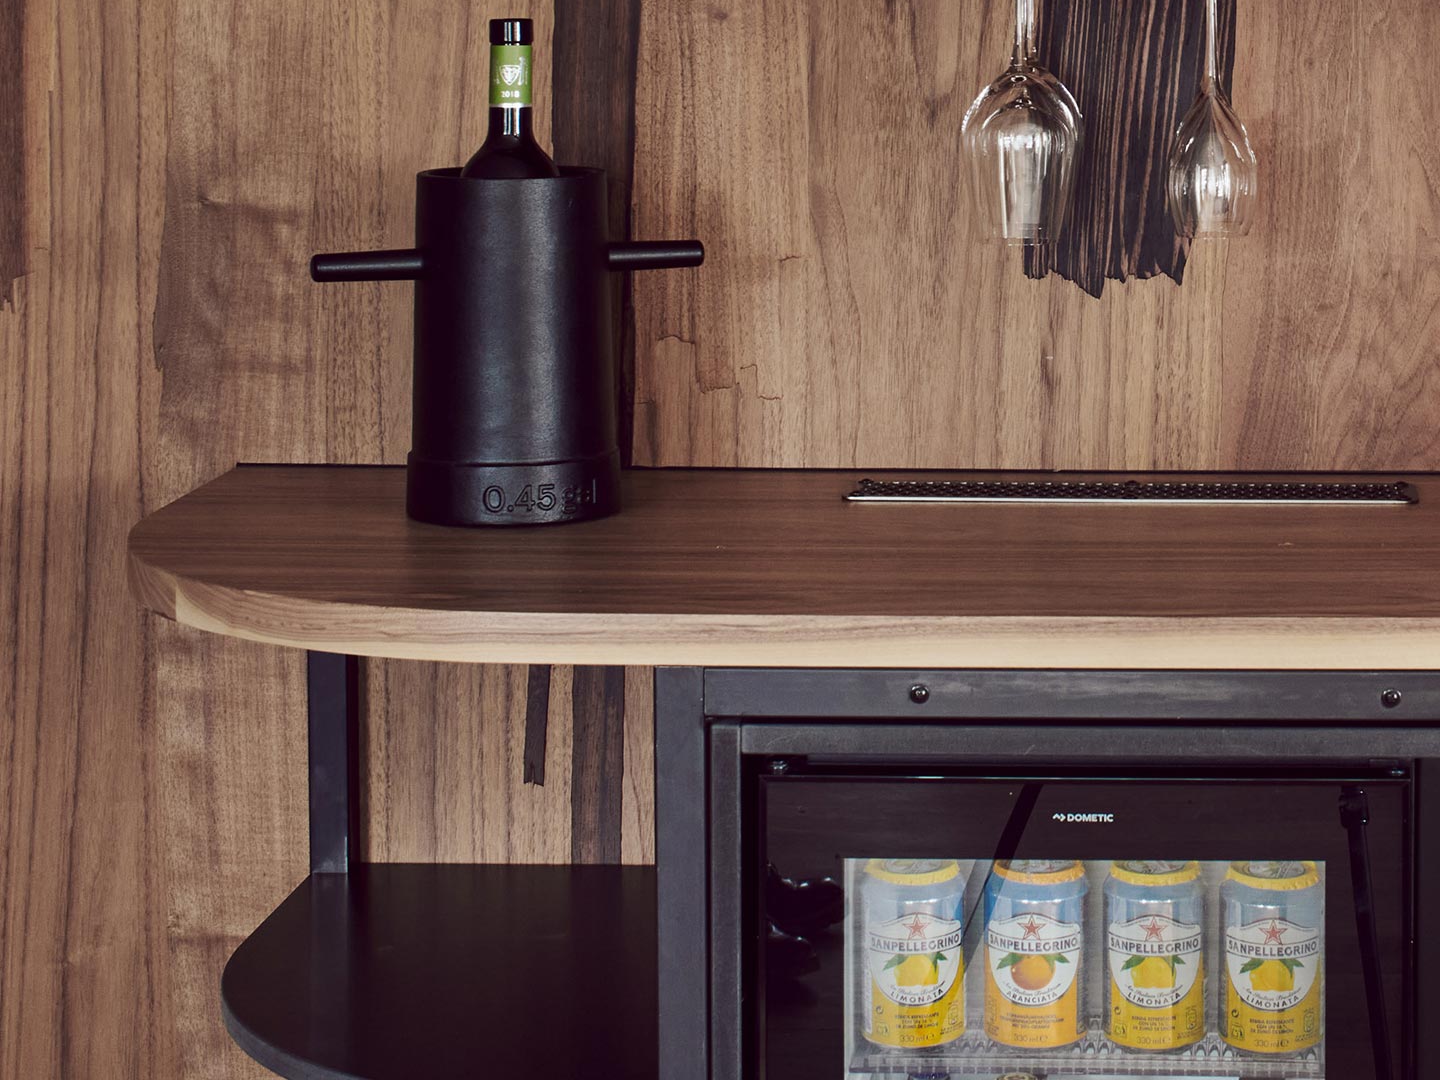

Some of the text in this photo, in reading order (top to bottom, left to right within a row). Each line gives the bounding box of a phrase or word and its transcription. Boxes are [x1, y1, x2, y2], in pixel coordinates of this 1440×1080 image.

[482, 483, 556, 514] 0.45
[1066, 813, 1114, 822] DOMETIC
[871, 933, 960, 952] SANPELLEGRINO
[989, 933, 1078, 952] SANPELLEGRINO
[1110, 937, 1199, 954] SANPELLEGRINO
[1228, 940, 1317, 957] SANPELLEGRINO
[890, 988, 943, 1003] LIMONATA
[1006, 991, 1058, 1003] ARANCIATA
[1127, 992, 1181, 1005] LIMONATA
[1246, 994, 1299, 1008] LIMONATA
